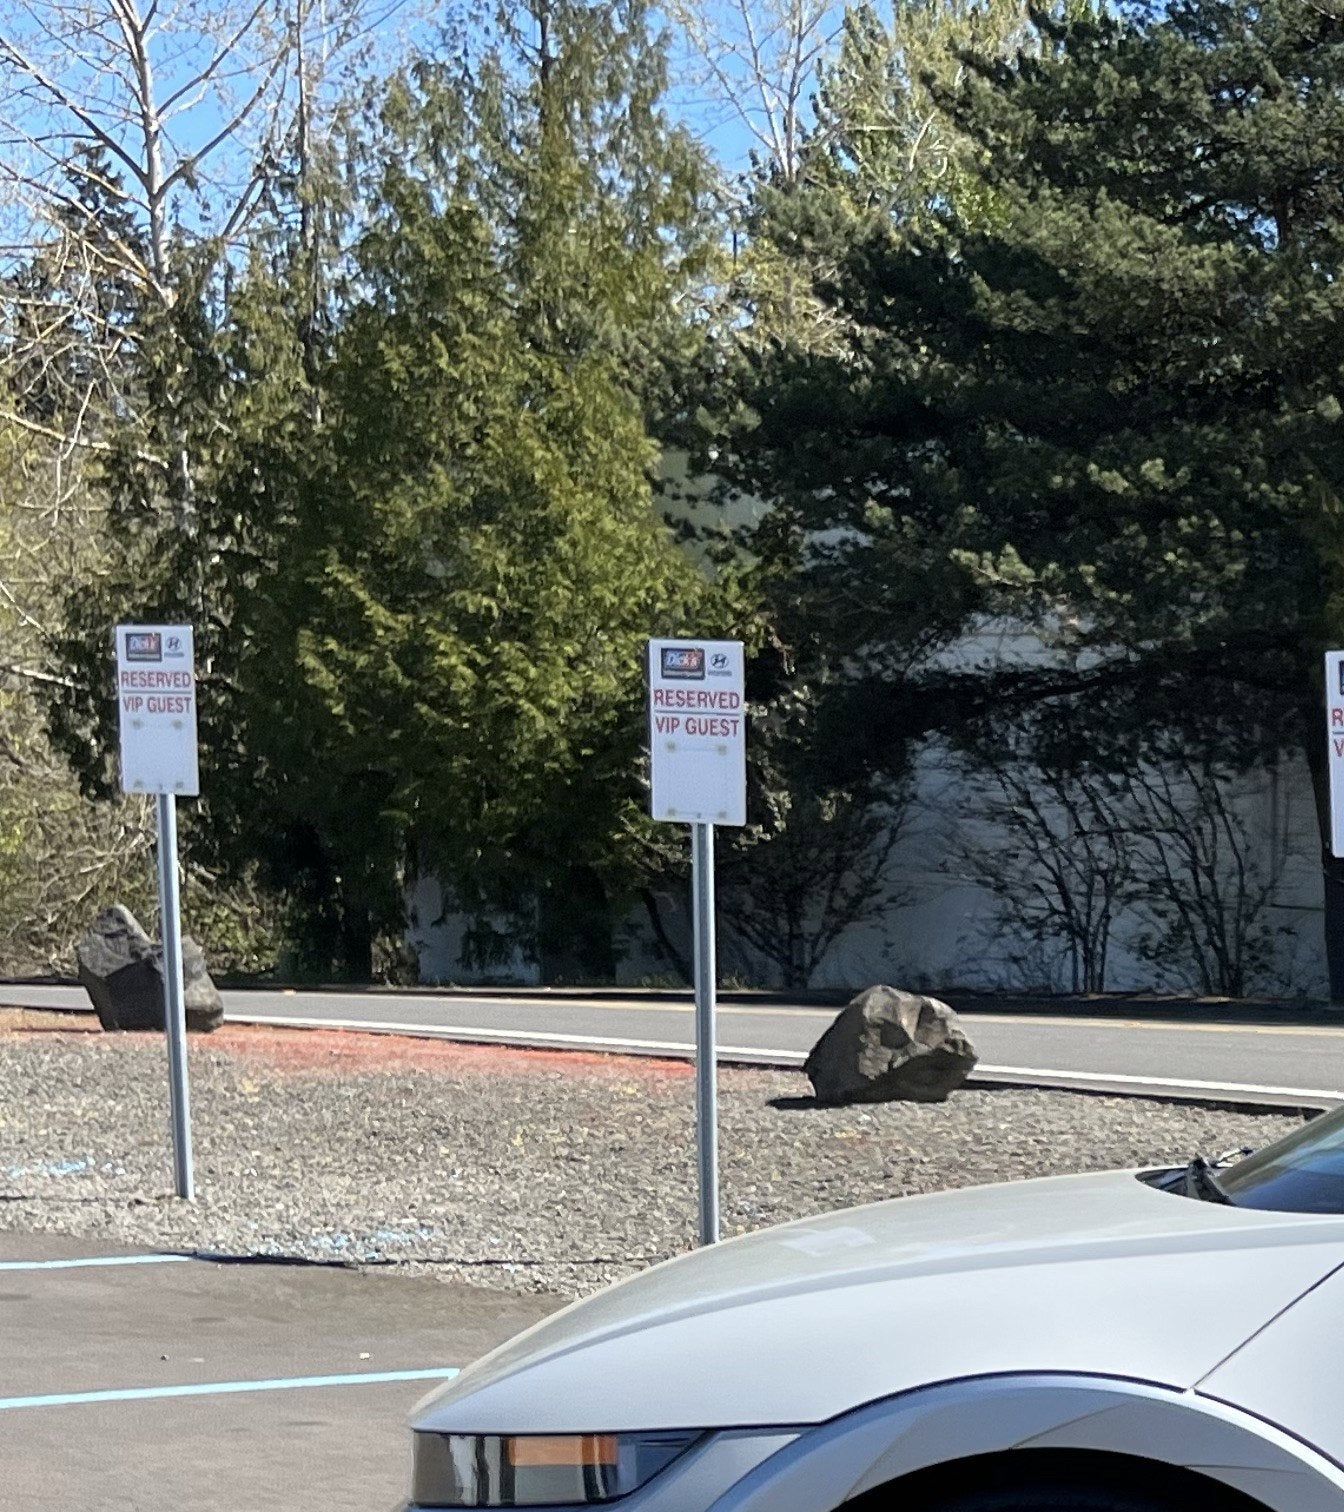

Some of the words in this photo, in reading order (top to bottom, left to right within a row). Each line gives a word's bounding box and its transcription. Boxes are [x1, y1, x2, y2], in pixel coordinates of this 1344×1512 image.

[121, 671, 191, 688] RESERVED
[122, 697, 143, 713] VIP
[147, 697, 191, 713] GUEST
[654, 689, 739, 709] RESERVED
[655, 716, 680, 734] VIP
[685, 717, 739, 737] GUEST
